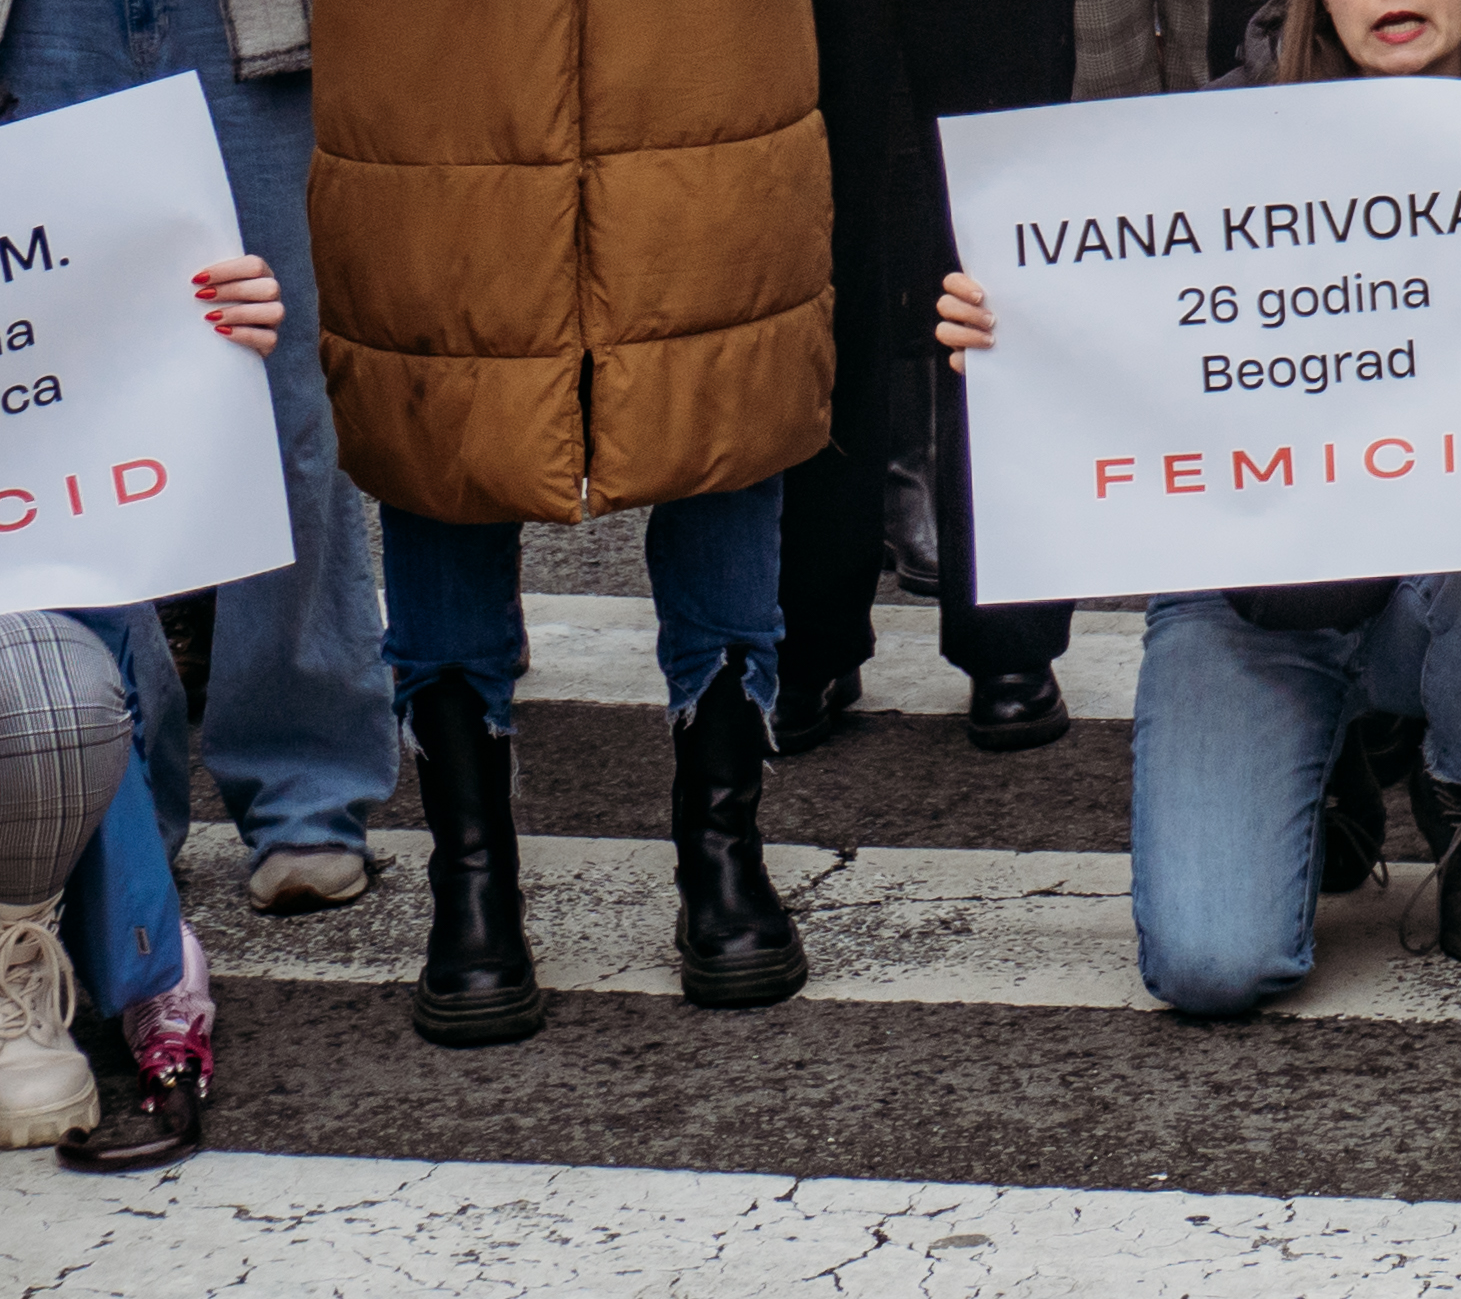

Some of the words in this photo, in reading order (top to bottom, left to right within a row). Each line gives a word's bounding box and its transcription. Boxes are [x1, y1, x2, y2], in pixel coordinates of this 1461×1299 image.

[1017, 212, 1201, 266] IVANA
[1178, 286, 1238, 326] 26
[1258, 273, 1429, 329] godina
[1203, 340, 1415, 394] Beograd
